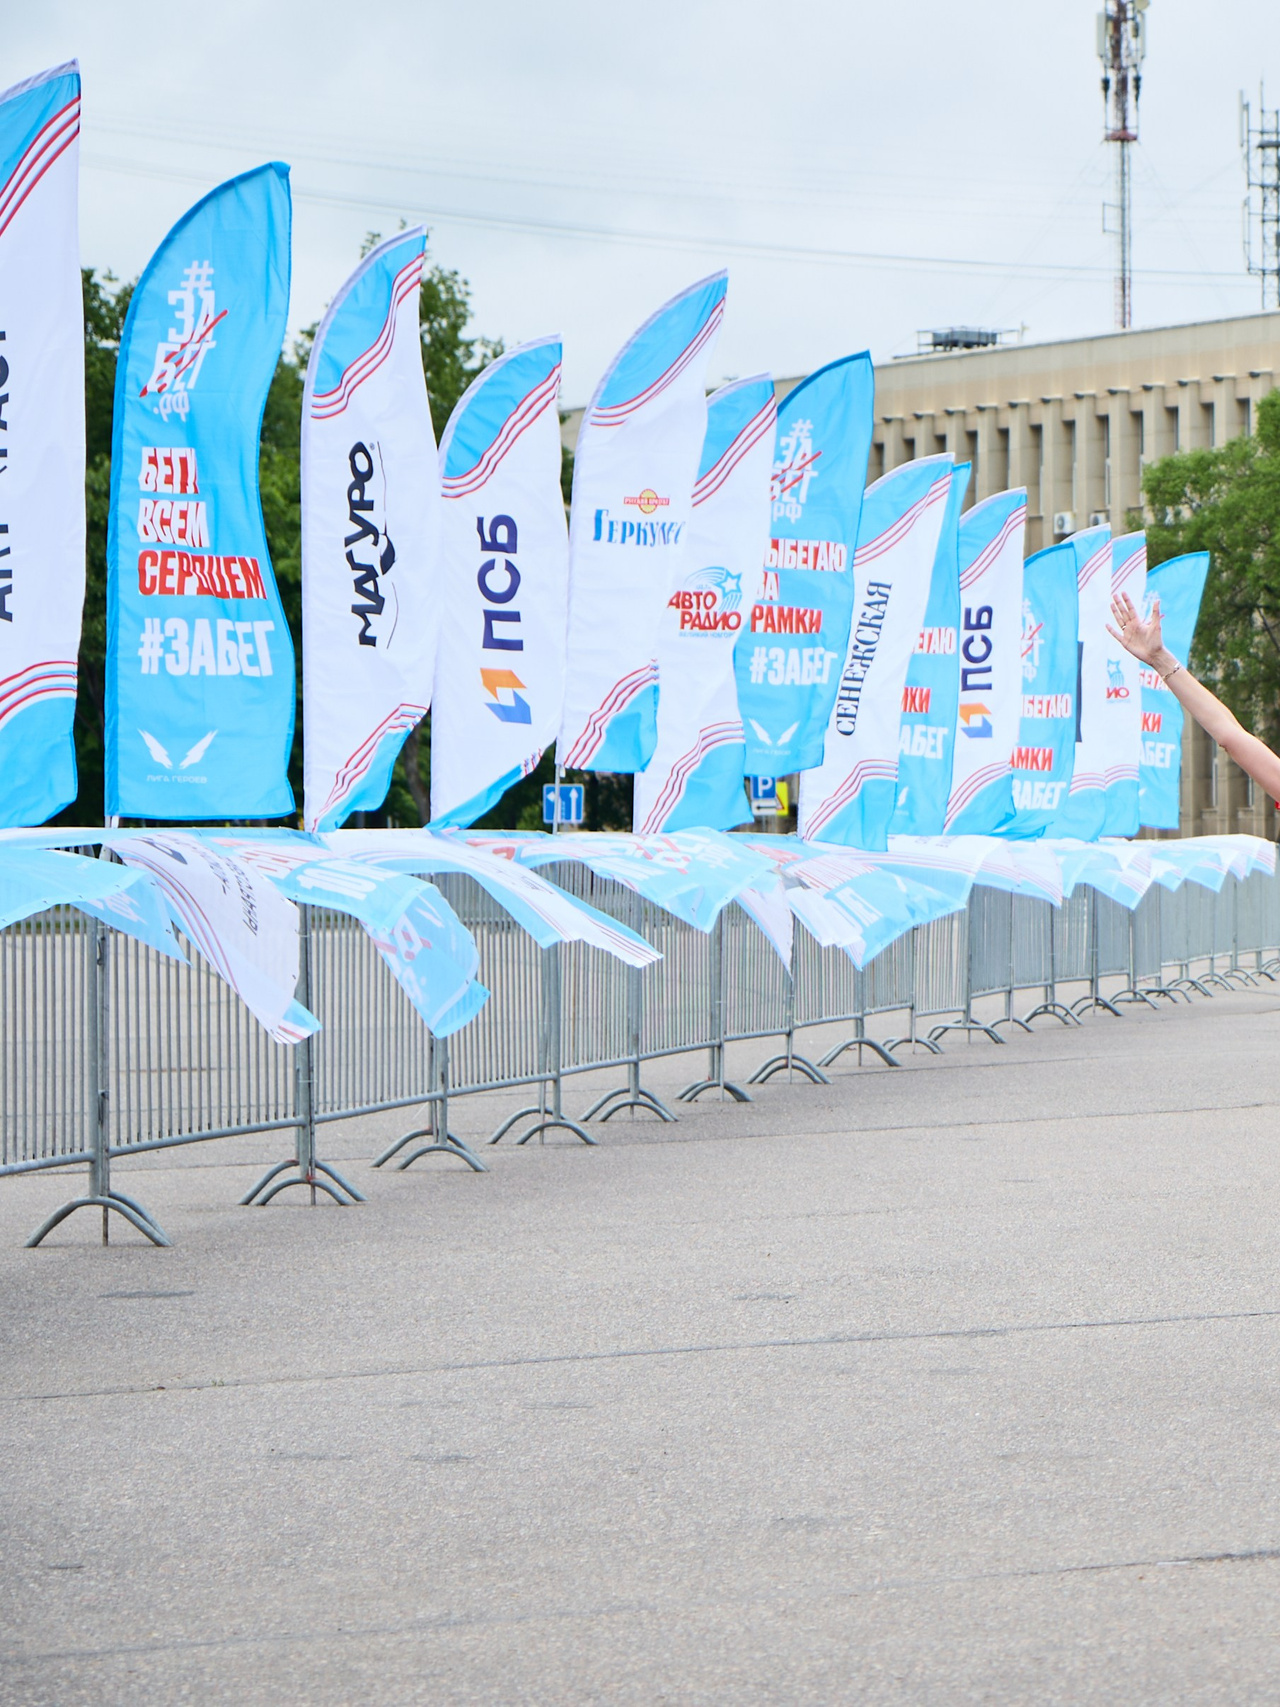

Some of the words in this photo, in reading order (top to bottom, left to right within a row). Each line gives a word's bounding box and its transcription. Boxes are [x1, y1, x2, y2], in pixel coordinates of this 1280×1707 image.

[137, 498, 209, 547] ВСЕМ
[138, 550, 266, 599] СЕРДЦЕМ
[764, 538, 847, 572] ЫБЕГАЮ
[476, 513, 525, 650] ПСБ
[667, 591, 717, 610] АВТО
[680, 611, 742, 630] РАДИО
[751, 604, 823, 634] РАМКИ
[138, 617, 275, 677] #ЗАБЕГ
[836, 580, 892, 736] СЕНЕЖСКАЯ
[961, 604, 993, 691] ПСБ
[757, 776, 773, 797] P
